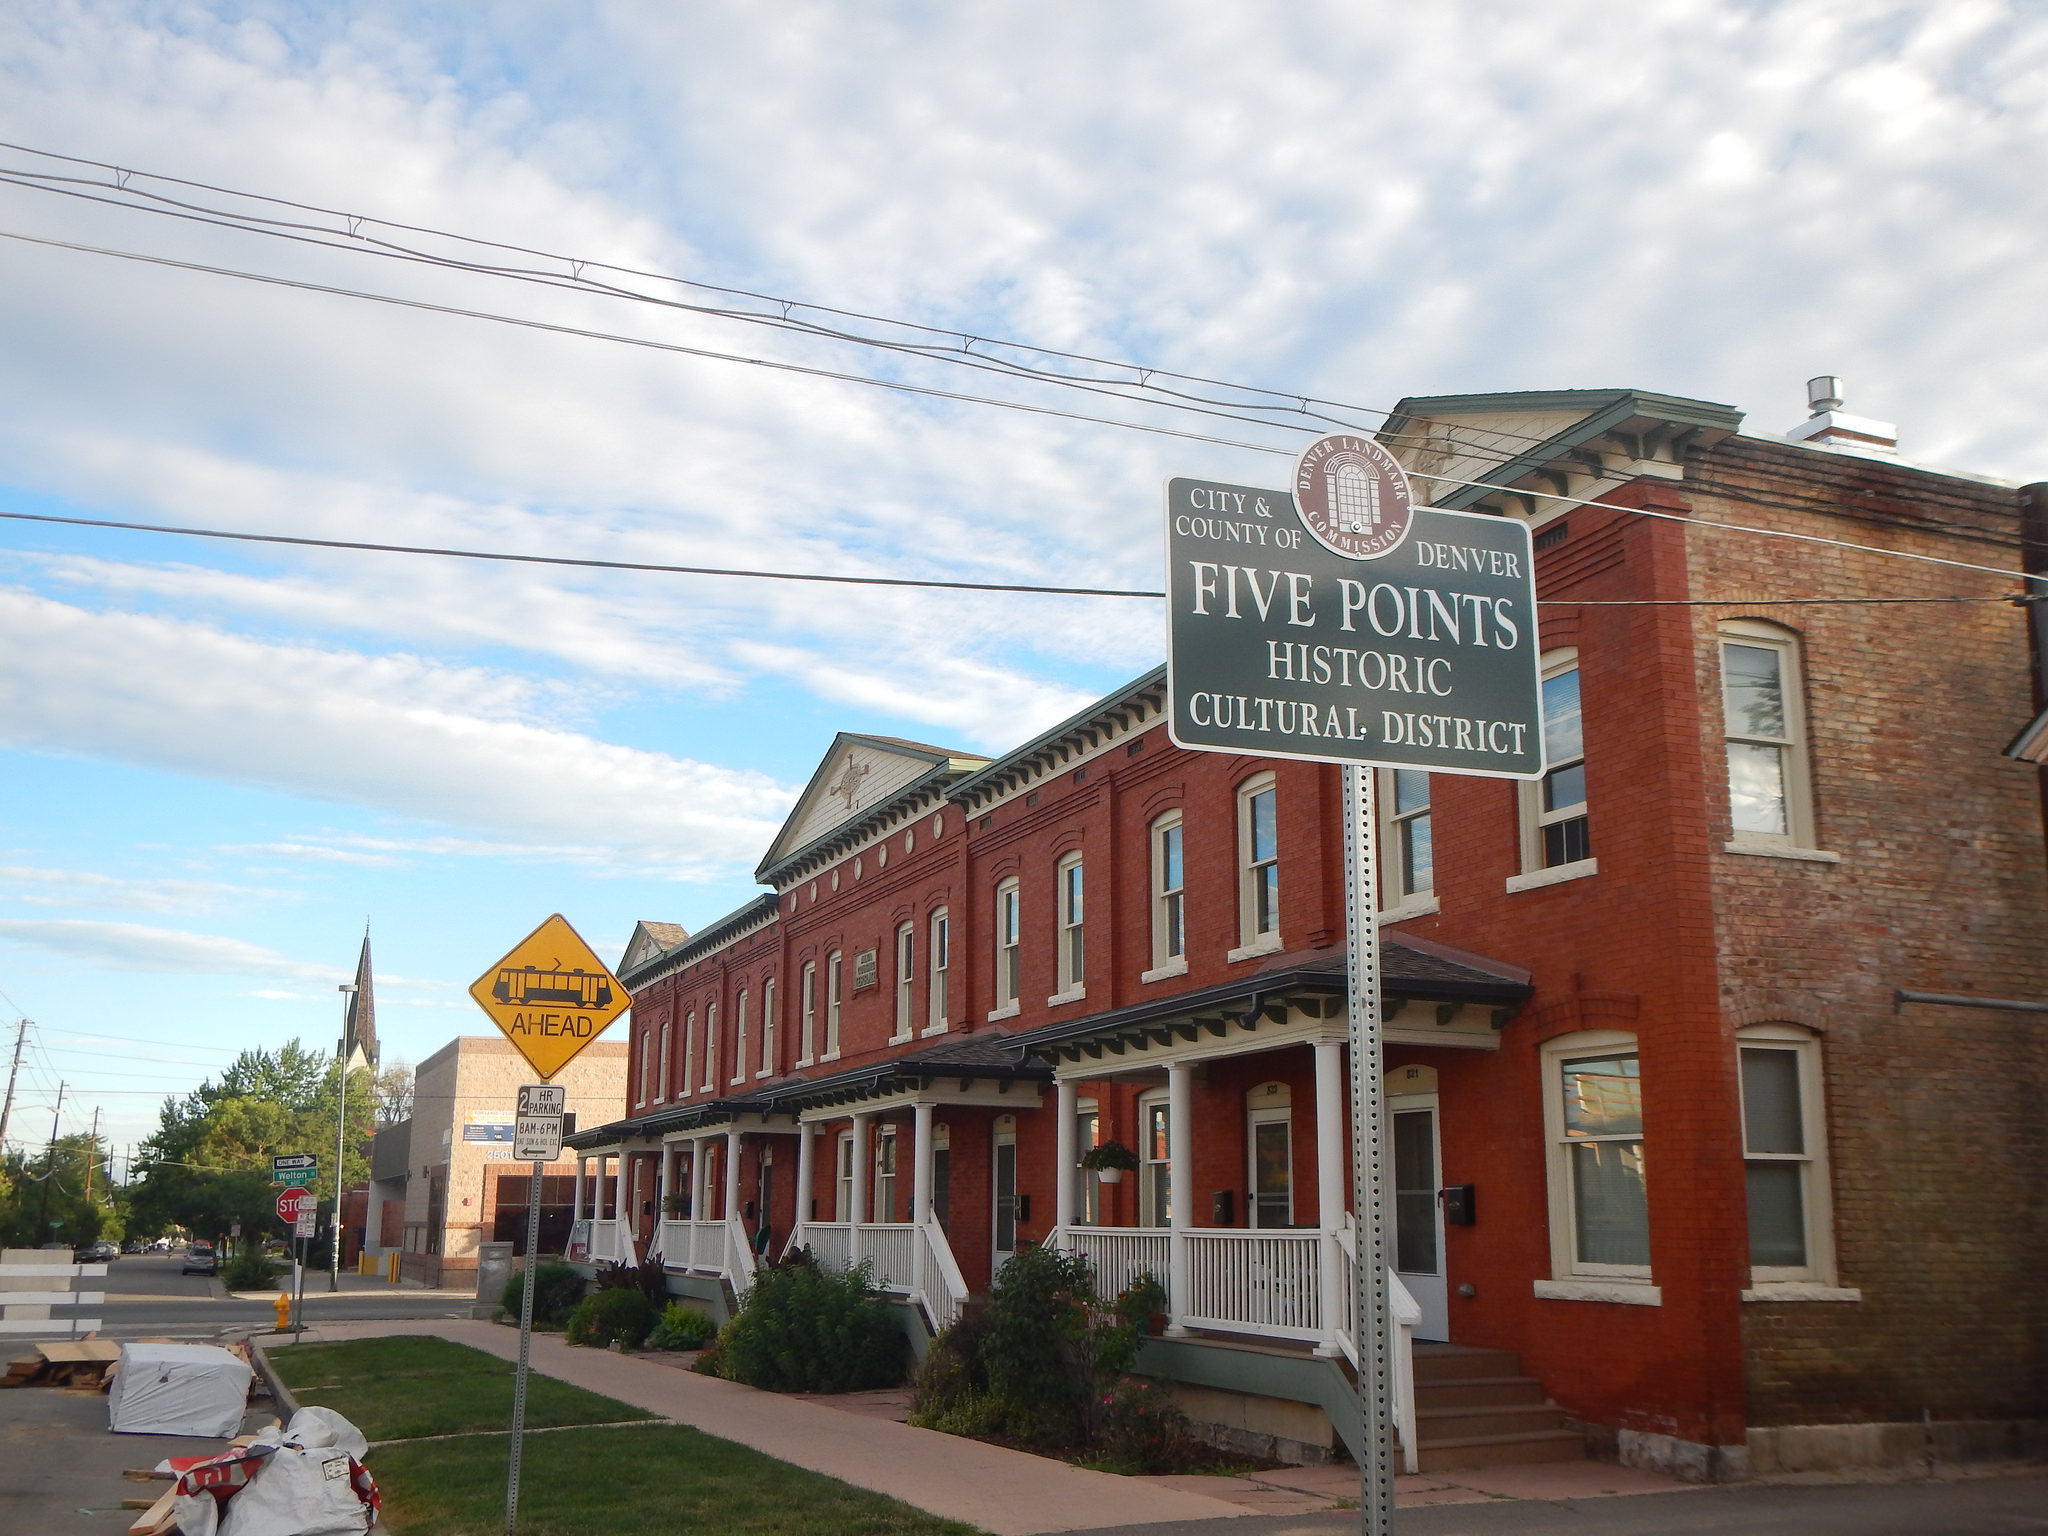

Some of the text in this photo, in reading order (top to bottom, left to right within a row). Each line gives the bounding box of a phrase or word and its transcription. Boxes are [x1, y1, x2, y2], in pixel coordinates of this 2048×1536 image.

[1299, 437, 1407, 500] DENVER LANDMARK
[1190, 487, 1273, 518] CITY &
[1175, 515, 1301, 551] COUNTY OF
[1308, 511, 1402, 553] COMMISSION
[1416, 540, 1521, 579] DENVER
[1188, 560, 1519, 650] FIVE POINTS
[1266, 640, 1453, 697] HISTORIC
[1189, 692, 1527, 755] CULTURAL DISTRICT
[510, 1012, 592, 1038] AHEAD
[519, 1090, 553, 1112] 2 HR
[529, 1103, 561, 1115] PARKING
[519, 1122, 558, 1135] 8AM-6PM
[279, 1172, 307, 1180] Welton
[280, 1199, 300, 1212] STO
